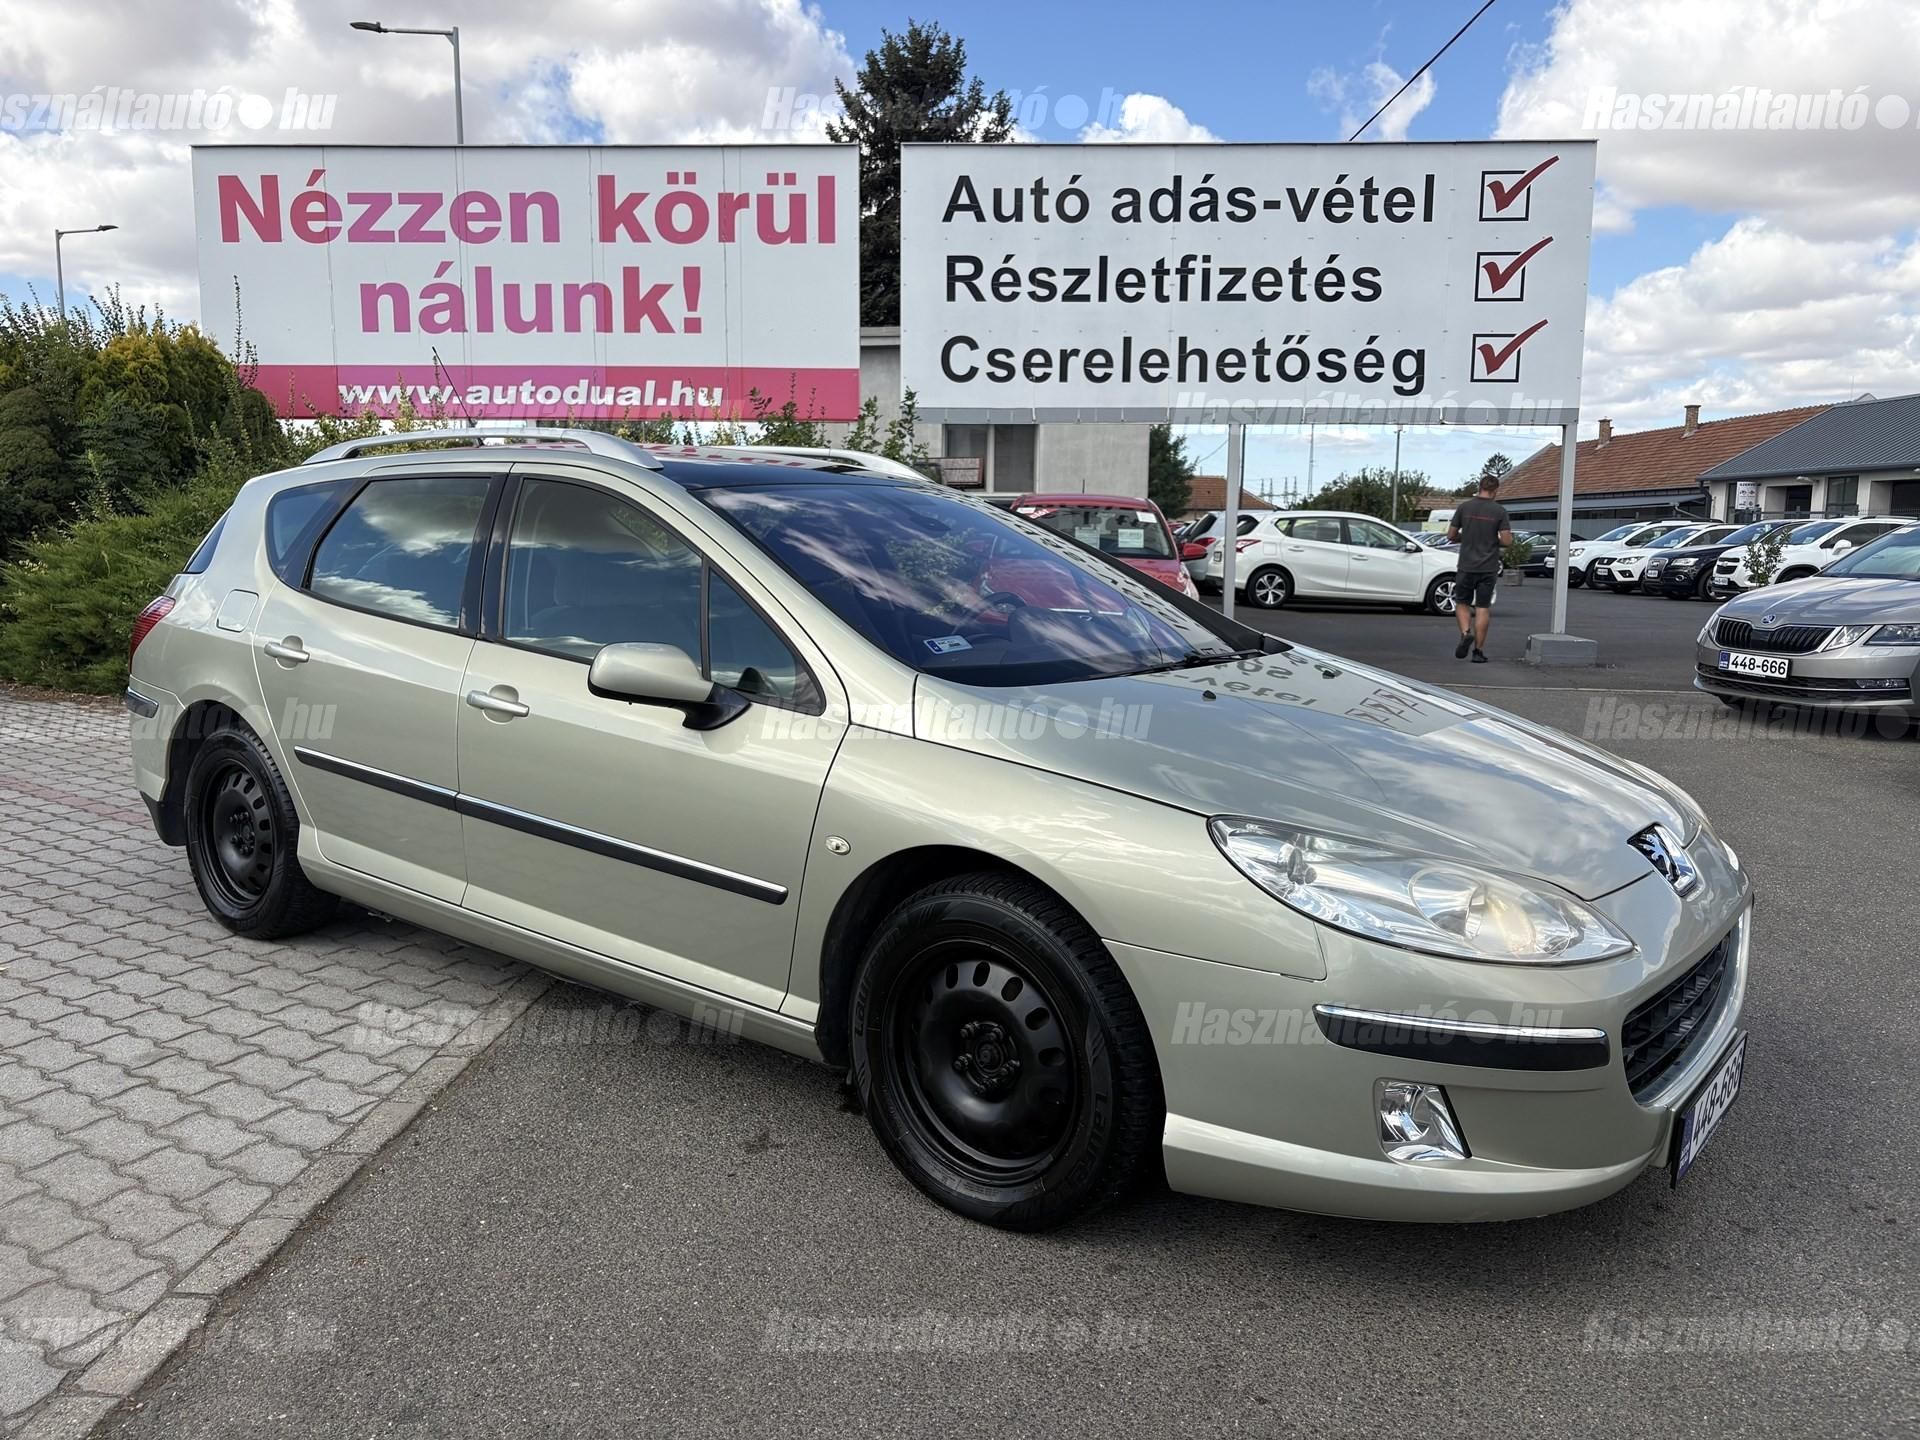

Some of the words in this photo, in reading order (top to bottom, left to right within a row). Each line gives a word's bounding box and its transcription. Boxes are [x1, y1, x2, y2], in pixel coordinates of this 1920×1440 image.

[219, 170, 559, 244] Nézzen
[599, 172, 836, 244] körül
[942, 174, 1090, 224] Autó
[1111, 173, 1435, 224] adás-vétel
[360, 261, 703, 334] nálunk!
[946, 253, 1382, 304] Részletfizetés
[338, 379, 723, 408] www.autodual.hu
[940, 333, 1427, 397] Cserelehetőség
[1731, 655, 1787, 675] 448-666
[1693, 1047, 1743, 1146] 448-666
